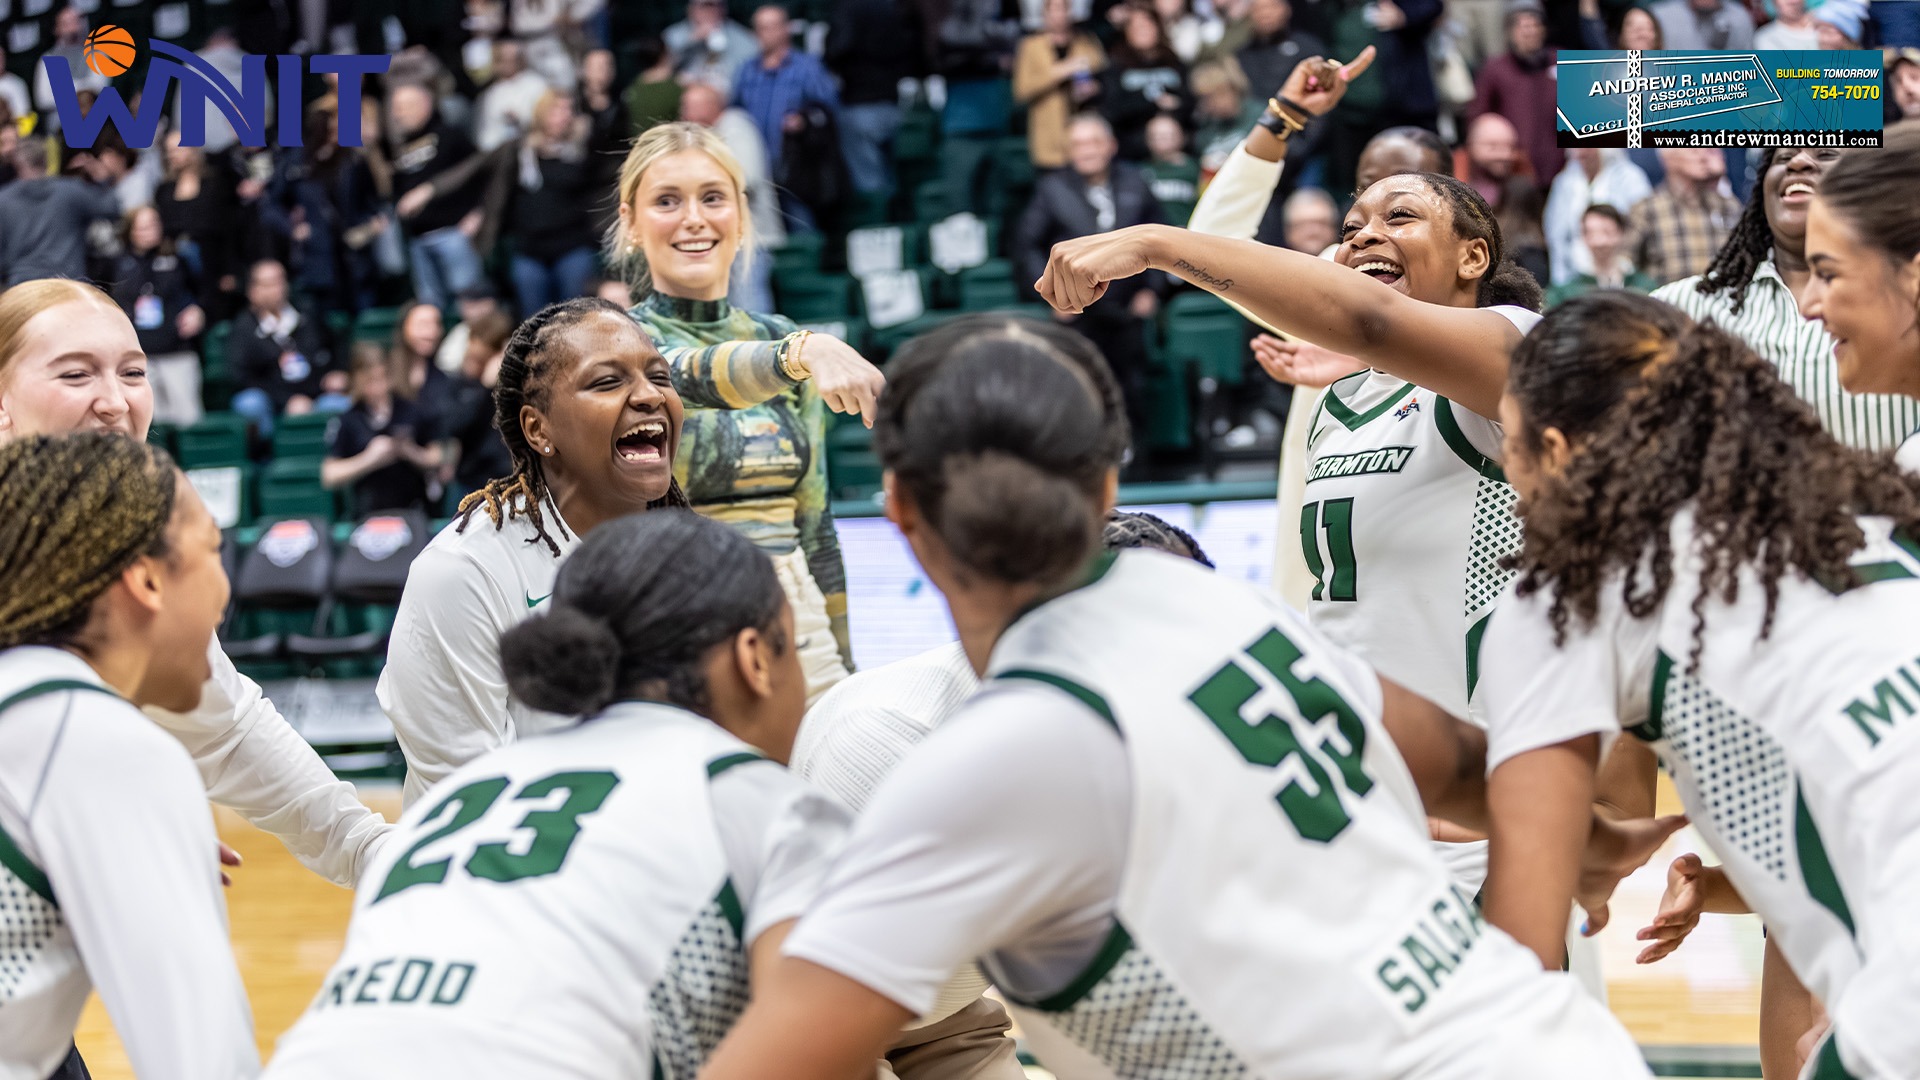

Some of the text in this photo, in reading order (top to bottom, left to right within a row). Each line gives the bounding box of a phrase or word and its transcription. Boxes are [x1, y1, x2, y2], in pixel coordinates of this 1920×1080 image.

[1300, 496, 1357, 602] 11
[1187, 626, 1375, 843] 55
[371, 771, 621, 905] 23
